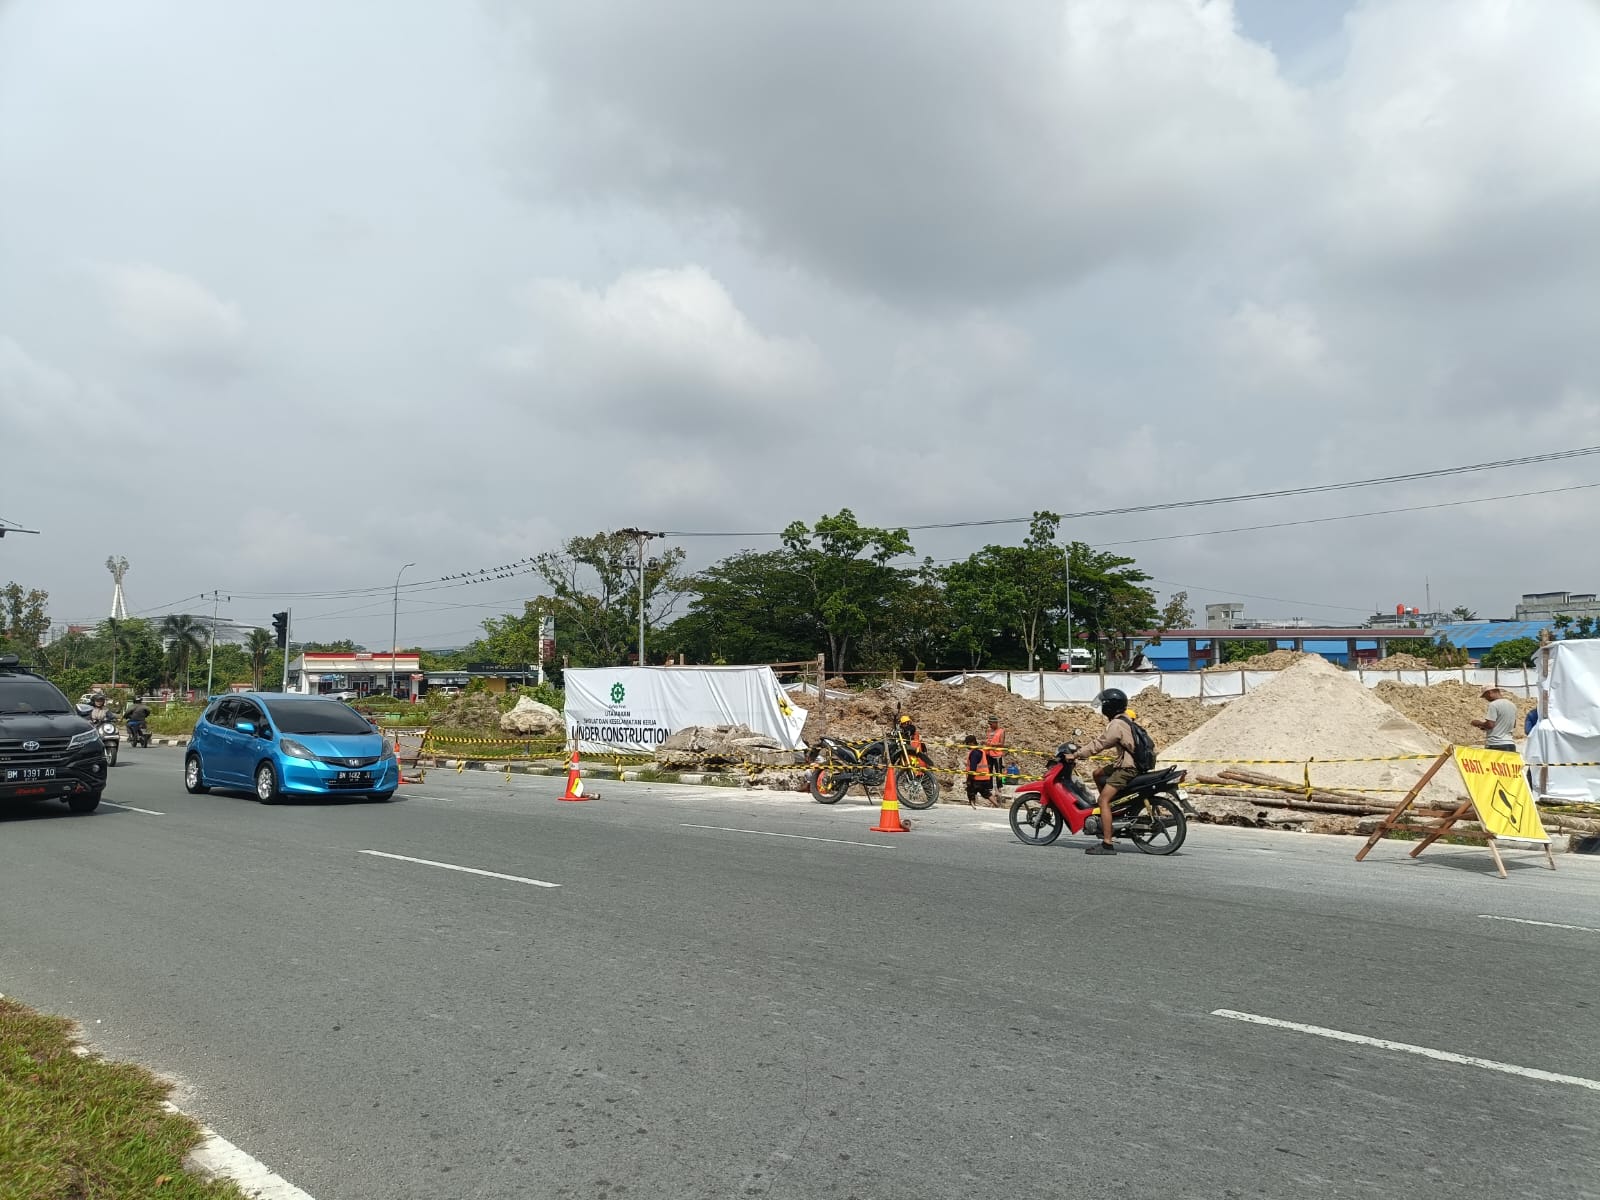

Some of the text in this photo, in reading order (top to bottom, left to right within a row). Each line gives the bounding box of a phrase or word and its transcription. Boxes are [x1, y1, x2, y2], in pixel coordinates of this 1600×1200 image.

[571, 725, 671, 744] UNDER CONSTRUCTION
[7, 770, 18, 779] BM
[23, 769, 40, 778] 1391
[1461, 759, 1484, 774] HATI
[1491, 762, 1511, 777] HATI
